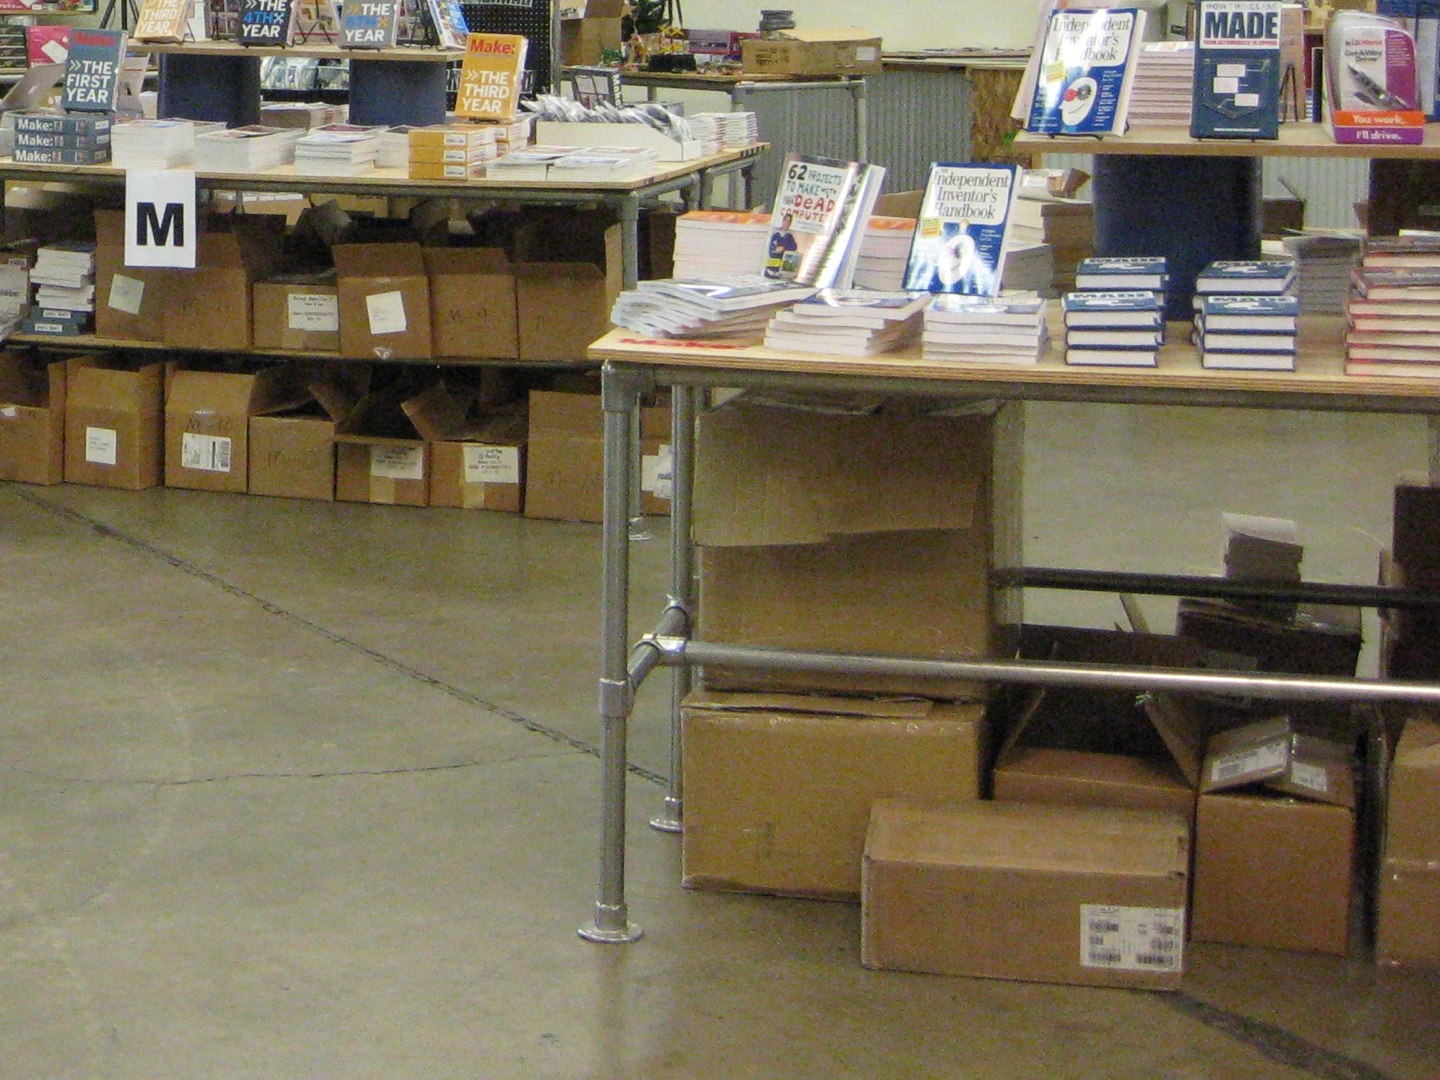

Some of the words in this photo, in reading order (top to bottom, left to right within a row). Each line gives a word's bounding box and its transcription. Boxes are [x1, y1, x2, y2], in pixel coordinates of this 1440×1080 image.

[143, 8, 178, 20] THIRD
[360, 3, 391, 16] THE
[242, 24, 281, 38] YEAR
[1052, 16, 1131, 34] Indepdent
[1204, 11, 1278, 39] MADE
[344, 29, 385, 42] YEAR
[469, 38, 516, 55] Make:
[81, 60, 113, 75] THE
[66, 73, 111, 89] FIRST
[479, 70, 509, 84] THE
[66, 87, 109, 103] YEAR
[464, 83, 510, 99] THIRD
[462, 98, 503, 112] YEAR
[17, 118, 53, 131] Make:
[1352, 114, 1371, 124] You
[17, 134, 54, 147] Make:
[1371, 130, 1402, 140] drive.
[15, 150, 52, 162] Make:
[788, 164, 808, 181] 62
[786, 180, 796, 192] TO
[798, 182, 820, 196] MAKE
[935, 171, 1010, 190] Independent
[937, 186, 998, 203] Inventor's
[135, 201, 185, 247] M
